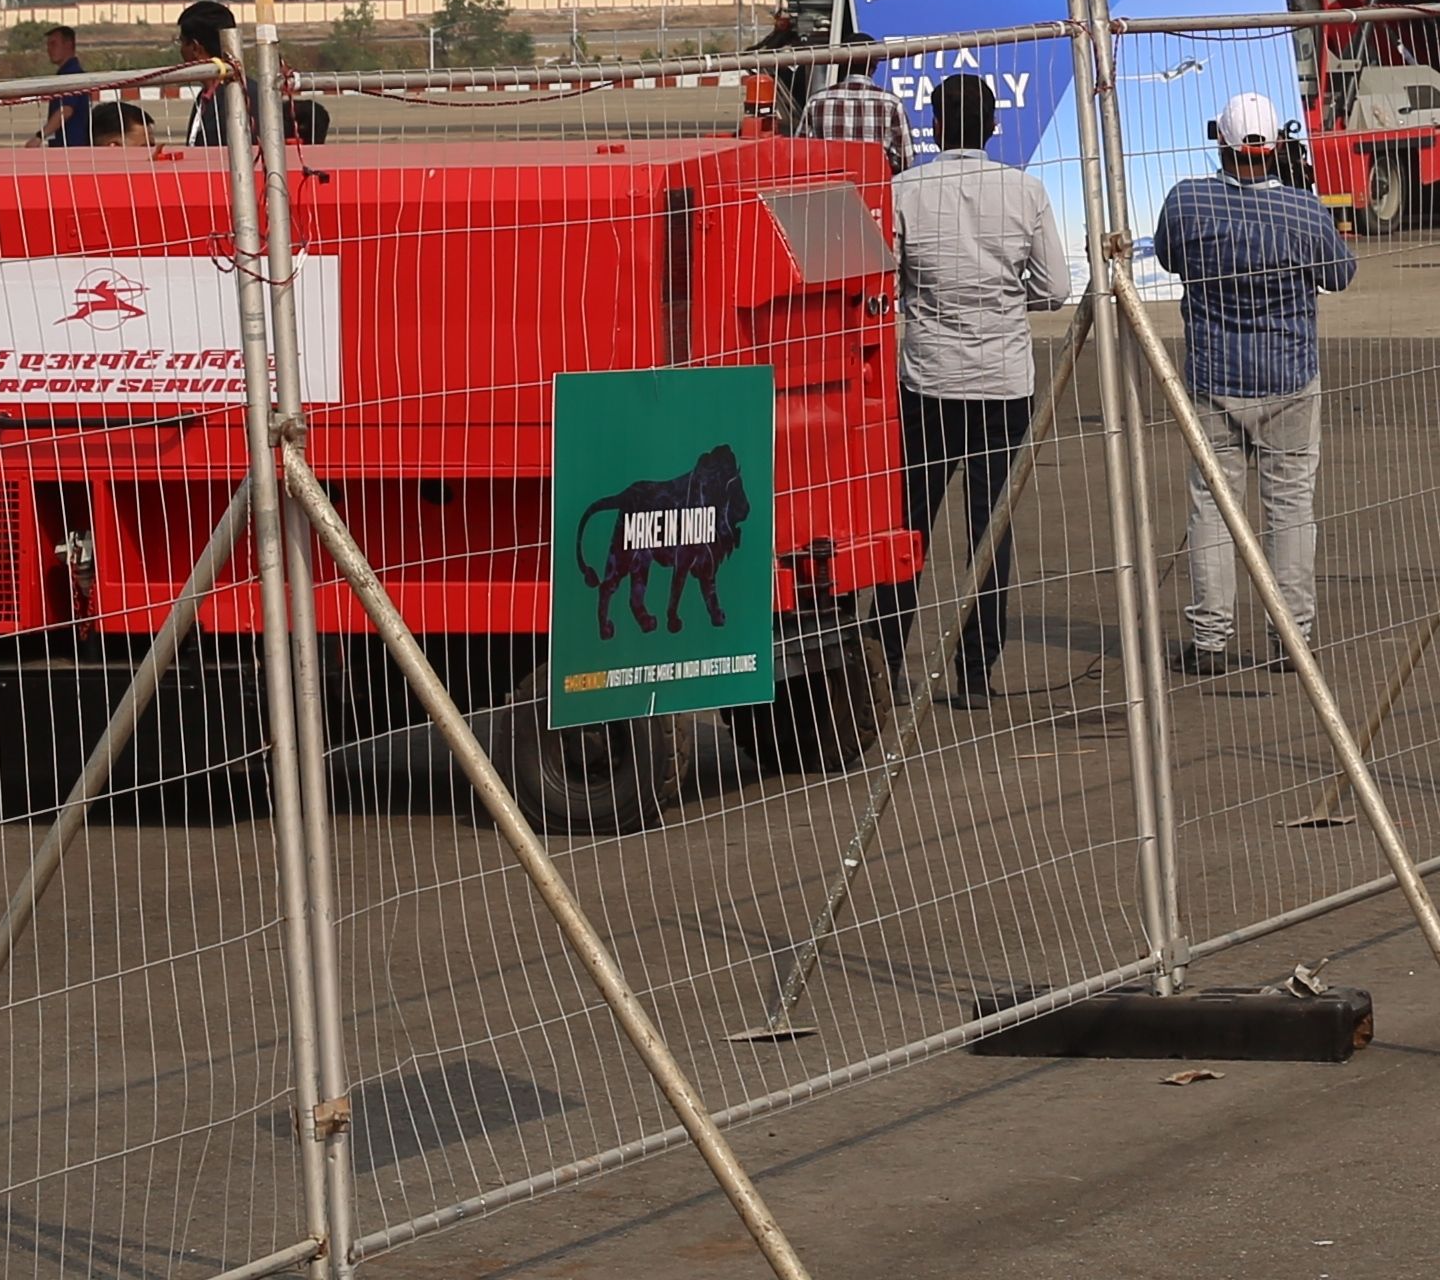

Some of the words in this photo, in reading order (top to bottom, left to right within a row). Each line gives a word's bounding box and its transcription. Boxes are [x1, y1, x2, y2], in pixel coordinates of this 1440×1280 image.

[892, 72, 1030, 111] FALY
[623, 510, 663, 551] MAKE
[664, 508, 678, 547] IN
[680, 506, 716, 545] INDIA
